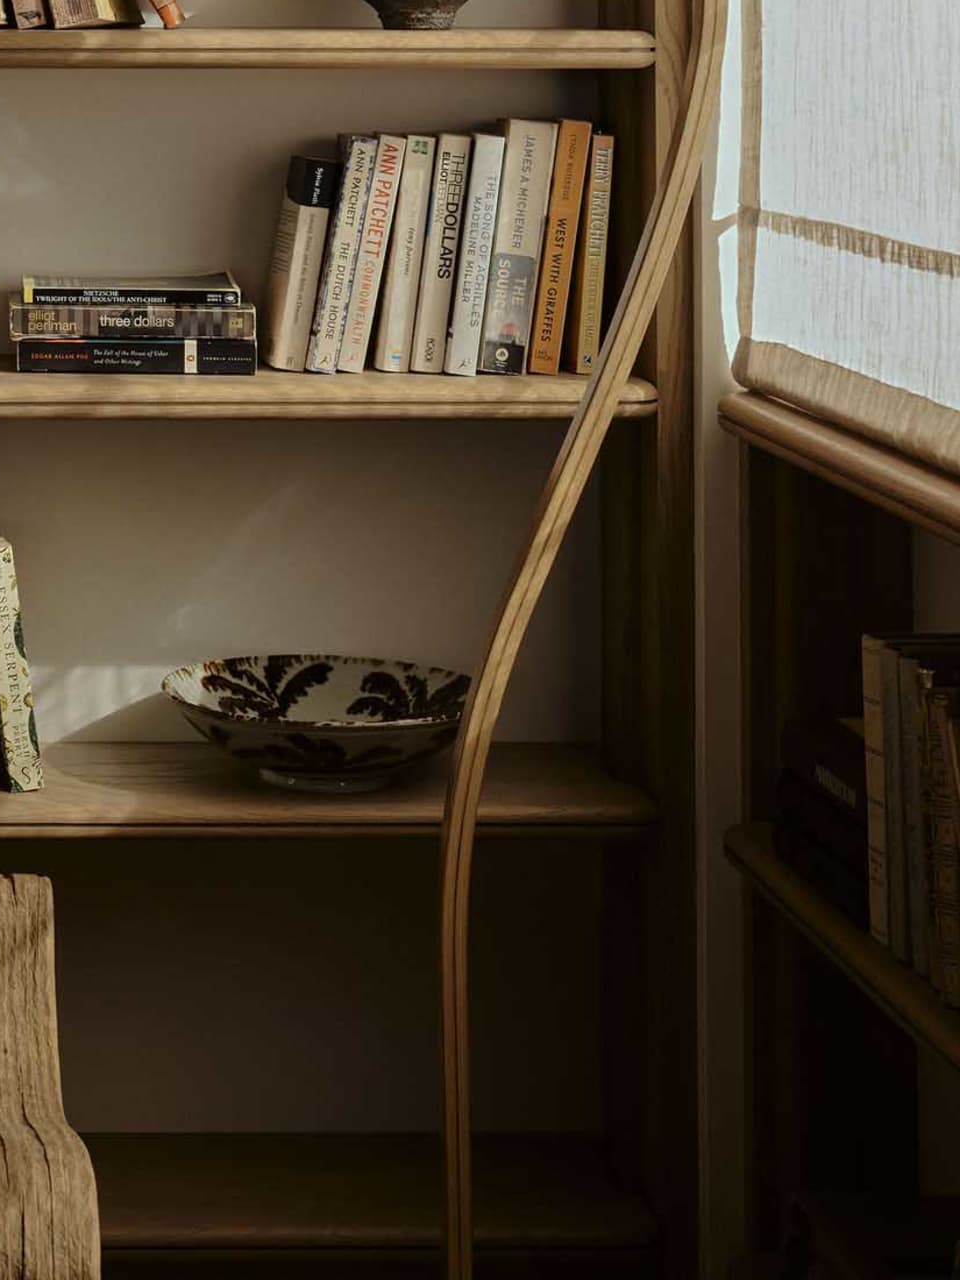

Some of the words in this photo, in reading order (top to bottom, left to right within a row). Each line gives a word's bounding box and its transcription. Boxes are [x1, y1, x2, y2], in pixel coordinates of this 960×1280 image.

[355, 147, 366, 174] ANN
[384, 142, 399, 176] ANN
[439, 151, 451, 185] ELLIOT
[520, 134, 537, 176] JAMES
[343, 174, 361, 228] PATCHETT
[486, 175, 498, 199] THE
[366, 179, 393, 260] PATCHETT
[466, 195, 483, 255] MADELINE
[483, 200, 495, 236] SONG
[512, 187, 529, 249] MICHENER
[556, 217, 568, 249] WEST
[588, 186, 608, 258] PRATCHETT
[340, 241, 350, 262] THE
[481, 240, 490, 260] OF
[332, 264, 346, 302] DUTCH
[461, 258, 474, 304] MILLER
[551, 251, 563, 285] WITH
[36, 295, 67, 303] TWILIGHT
[351, 260, 374, 346] COMMONWEALTH
[470, 264, 487, 328] ACHILLES
[511, 275, 527, 306] THE
[27, 310, 56, 321] elliot
[27, 320, 77, 333] perlman
[99, 315, 131, 328] three
[134, 315, 176, 328] dollars
[324, 305, 338, 341] HOUSE
[540, 287, 559, 342] GIRAFFES
[31, 352, 52, 360] EDGAR
[4, 641, 20, 714] SERPENT
